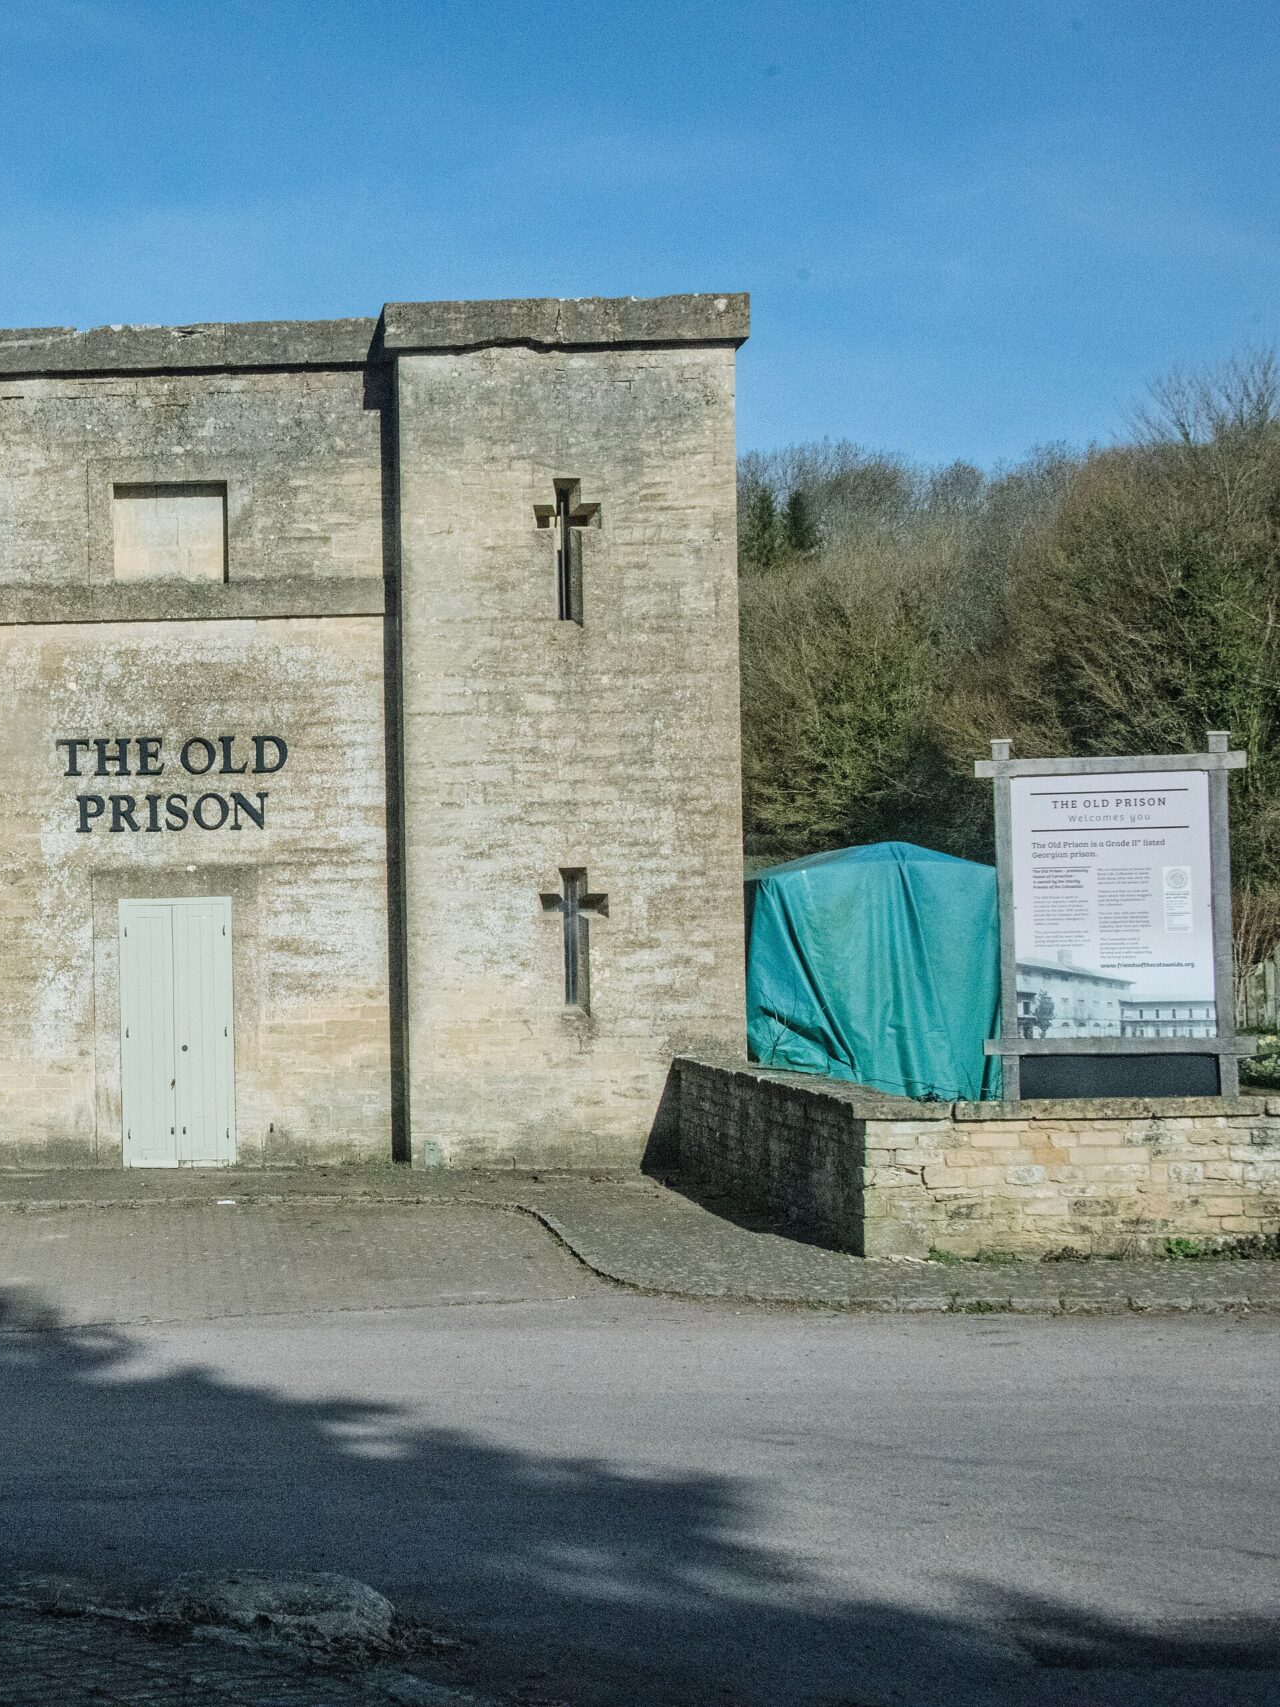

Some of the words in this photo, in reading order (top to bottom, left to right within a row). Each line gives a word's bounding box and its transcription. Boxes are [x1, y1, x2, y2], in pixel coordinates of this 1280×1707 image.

[55, 737, 166, 777] THE
[180, 735, 289, 775] OLD
[1051, 800, 1078, 810] THE
[1082, 799, 1110, 808] OLD
[1115, 797, 1167, 808] PRISON
[75, 791, 270, 833] PRISON
[1068, 814, 1126, 822] Welcomes
[1129, 814, 1152, 823] you
[1143, 839, 1165, 847] listed
[1031, 851, 1068, 860] Georgian
[1069, 851, 1098, 859] prison.
